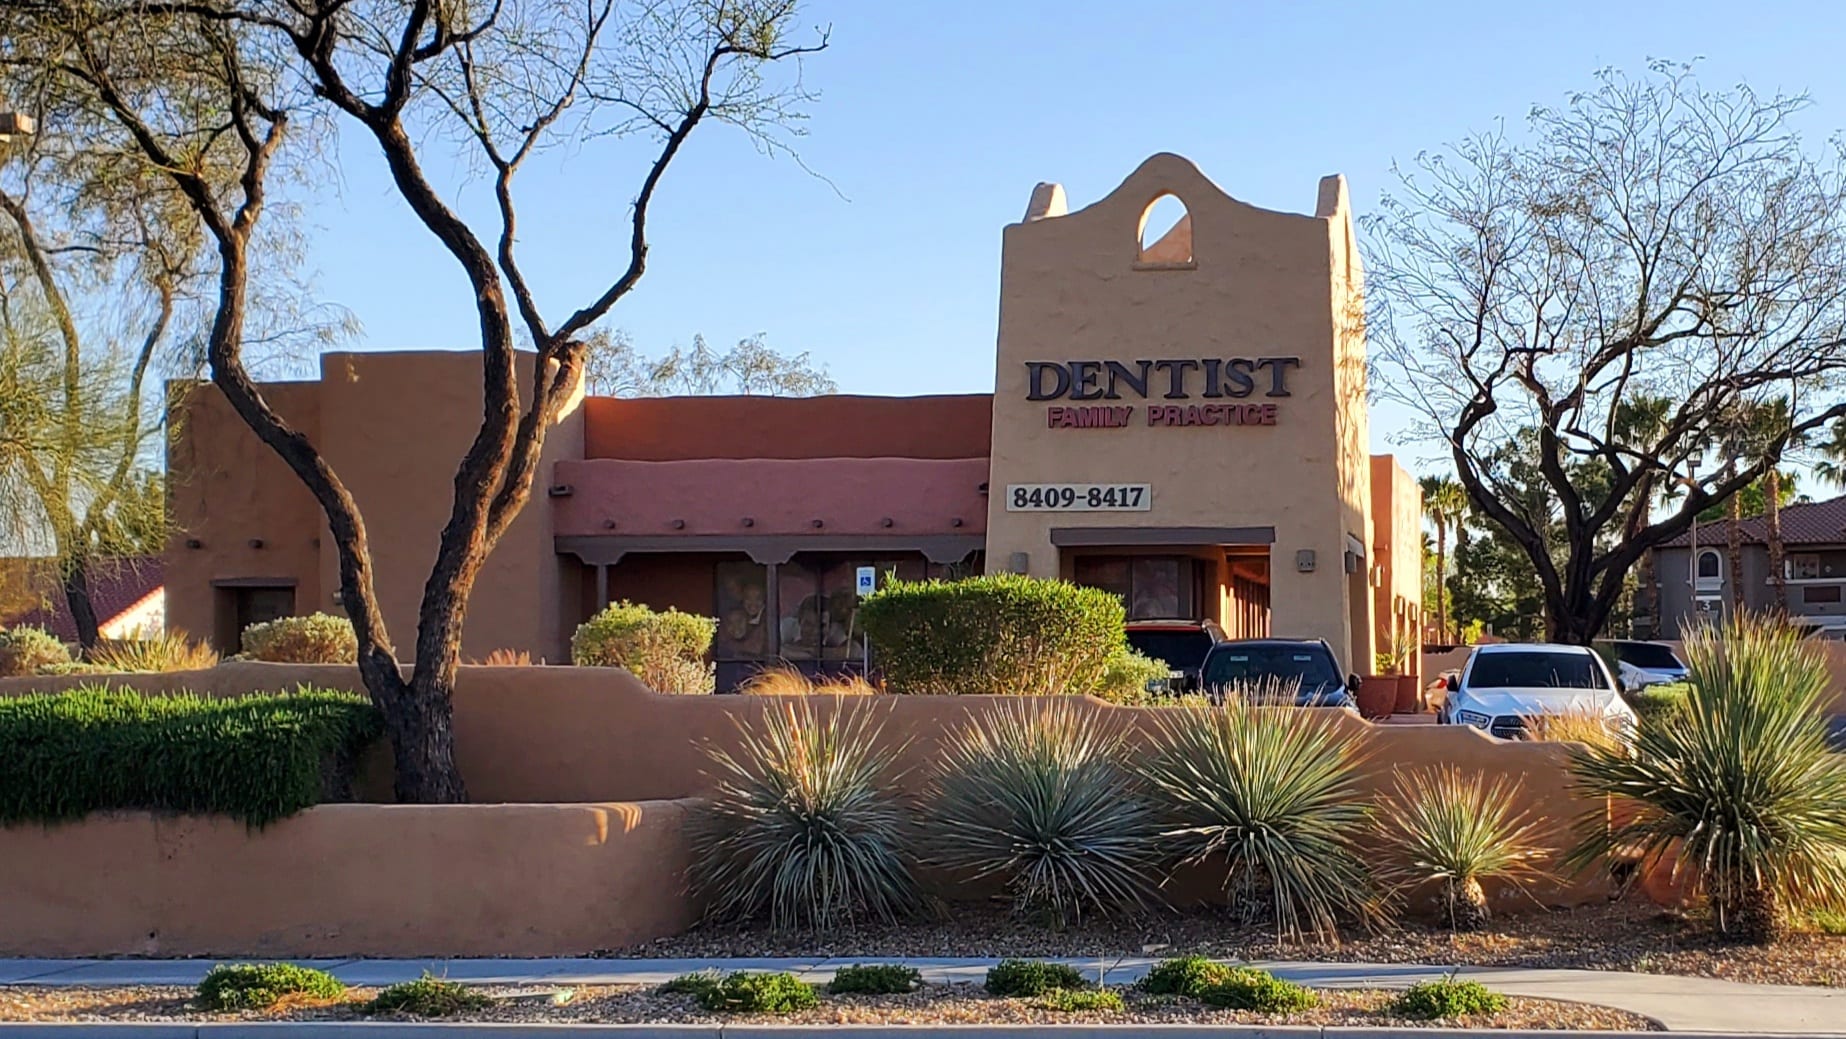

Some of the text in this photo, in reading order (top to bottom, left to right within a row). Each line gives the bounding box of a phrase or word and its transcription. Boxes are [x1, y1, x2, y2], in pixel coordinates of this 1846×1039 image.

[1024, 357, 1300, 401] DENTIST
[1047, 403, 1277, 428] FAMILY PRACTICE
[1013, 487, 1144, 508] 8409-8417
[1702, 600, 1711, 610] 3
